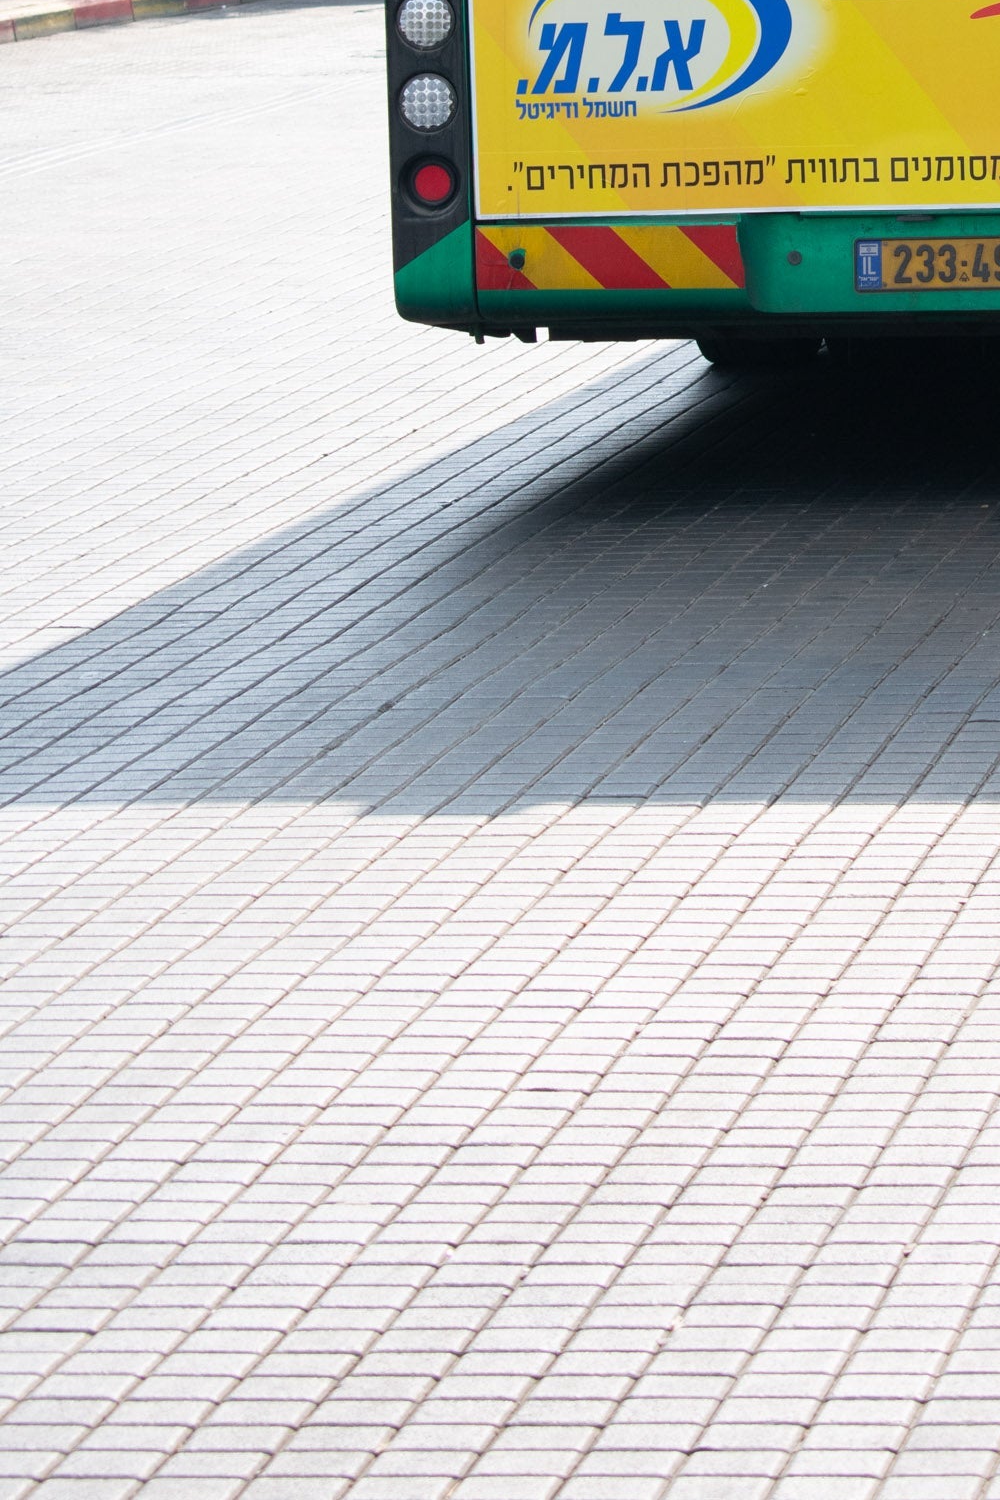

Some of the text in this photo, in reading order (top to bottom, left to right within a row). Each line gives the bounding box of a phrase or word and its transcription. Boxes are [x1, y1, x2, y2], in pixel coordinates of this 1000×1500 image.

[516, 12, 706, 95] א.ל.מ.
[515, 98, 637, 120] חשמל ודיגיטל
[784, 157, 880, 184] בתווית
[862, 256, 876, 275] IL
